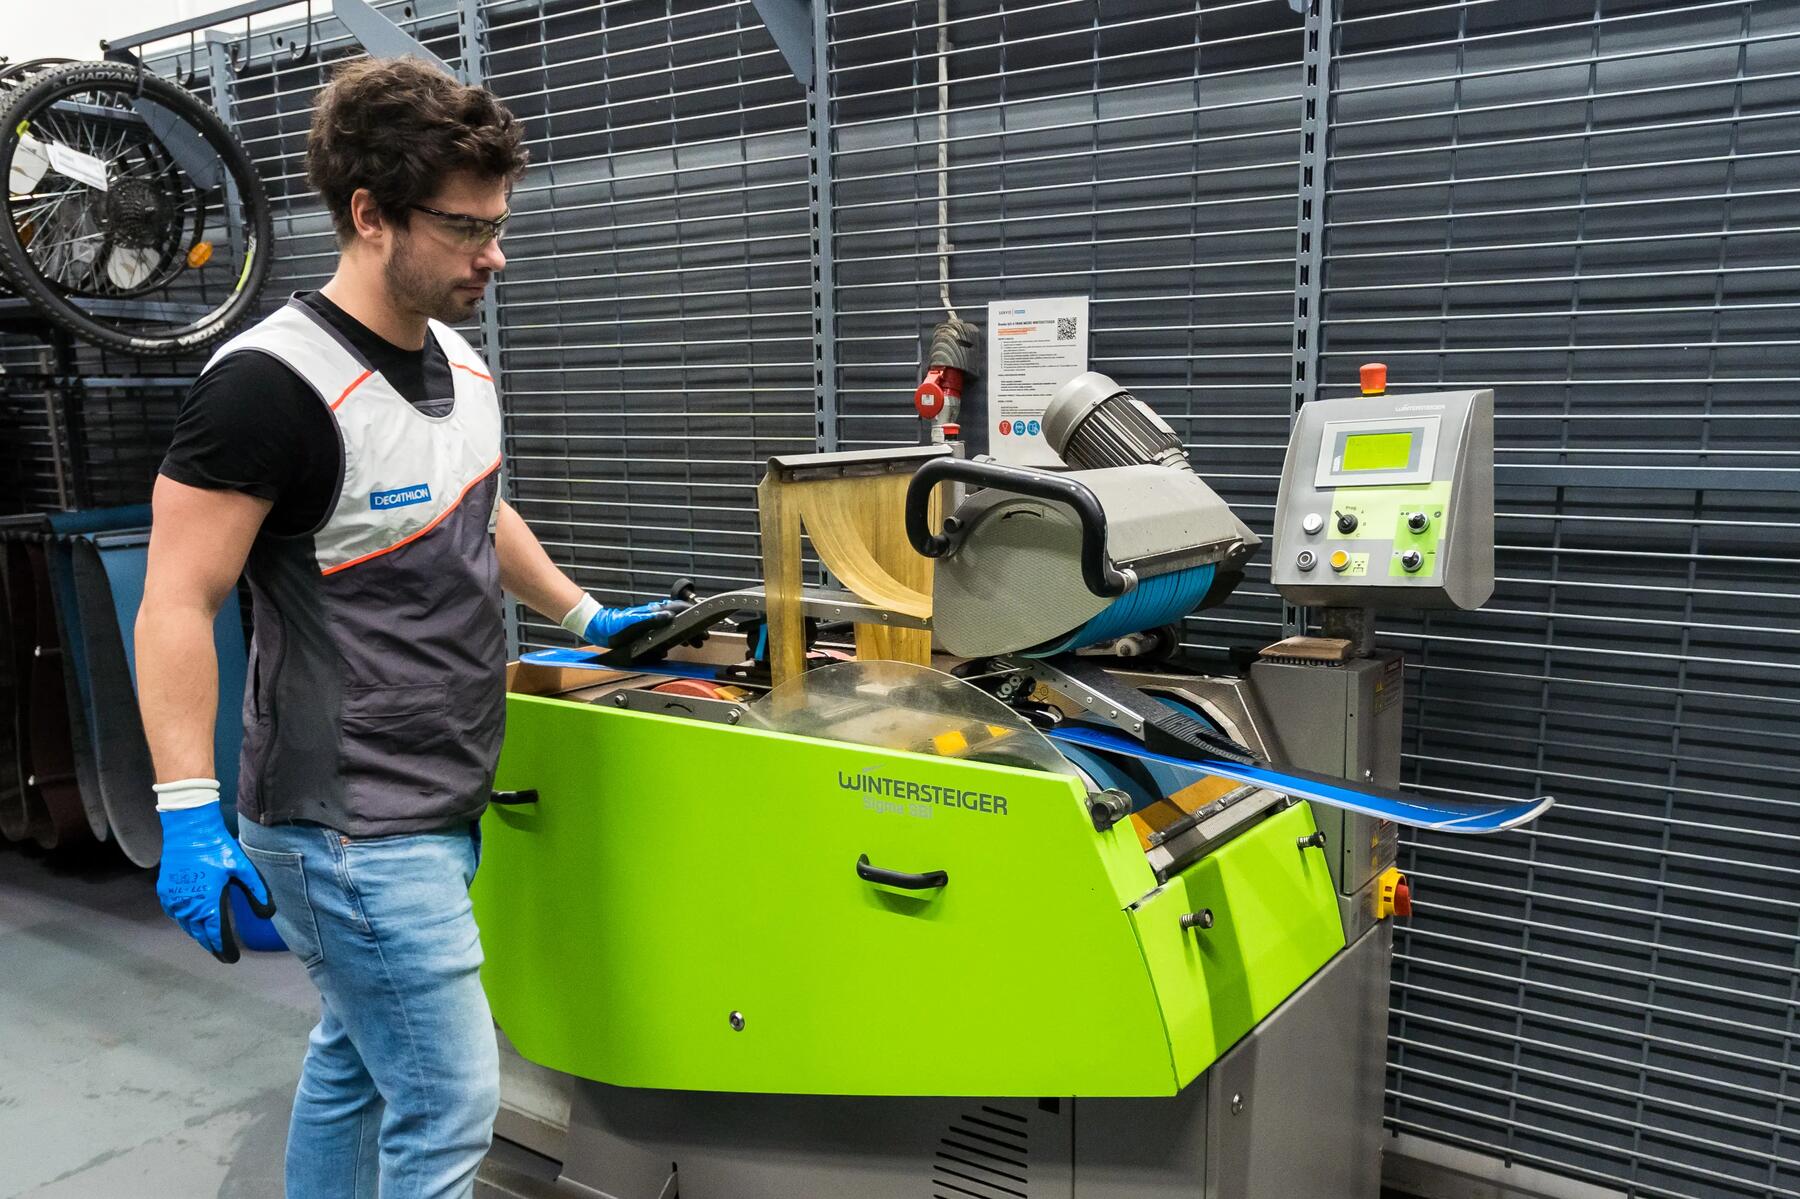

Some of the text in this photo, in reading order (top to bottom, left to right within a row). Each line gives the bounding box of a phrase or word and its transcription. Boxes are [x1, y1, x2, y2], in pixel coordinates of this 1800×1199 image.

[374, 488, 429, 506] DECATHLON
[838, 771, 1008, 816] WINTERSTEIGER
[863, 796, 905, 815] Sigma
